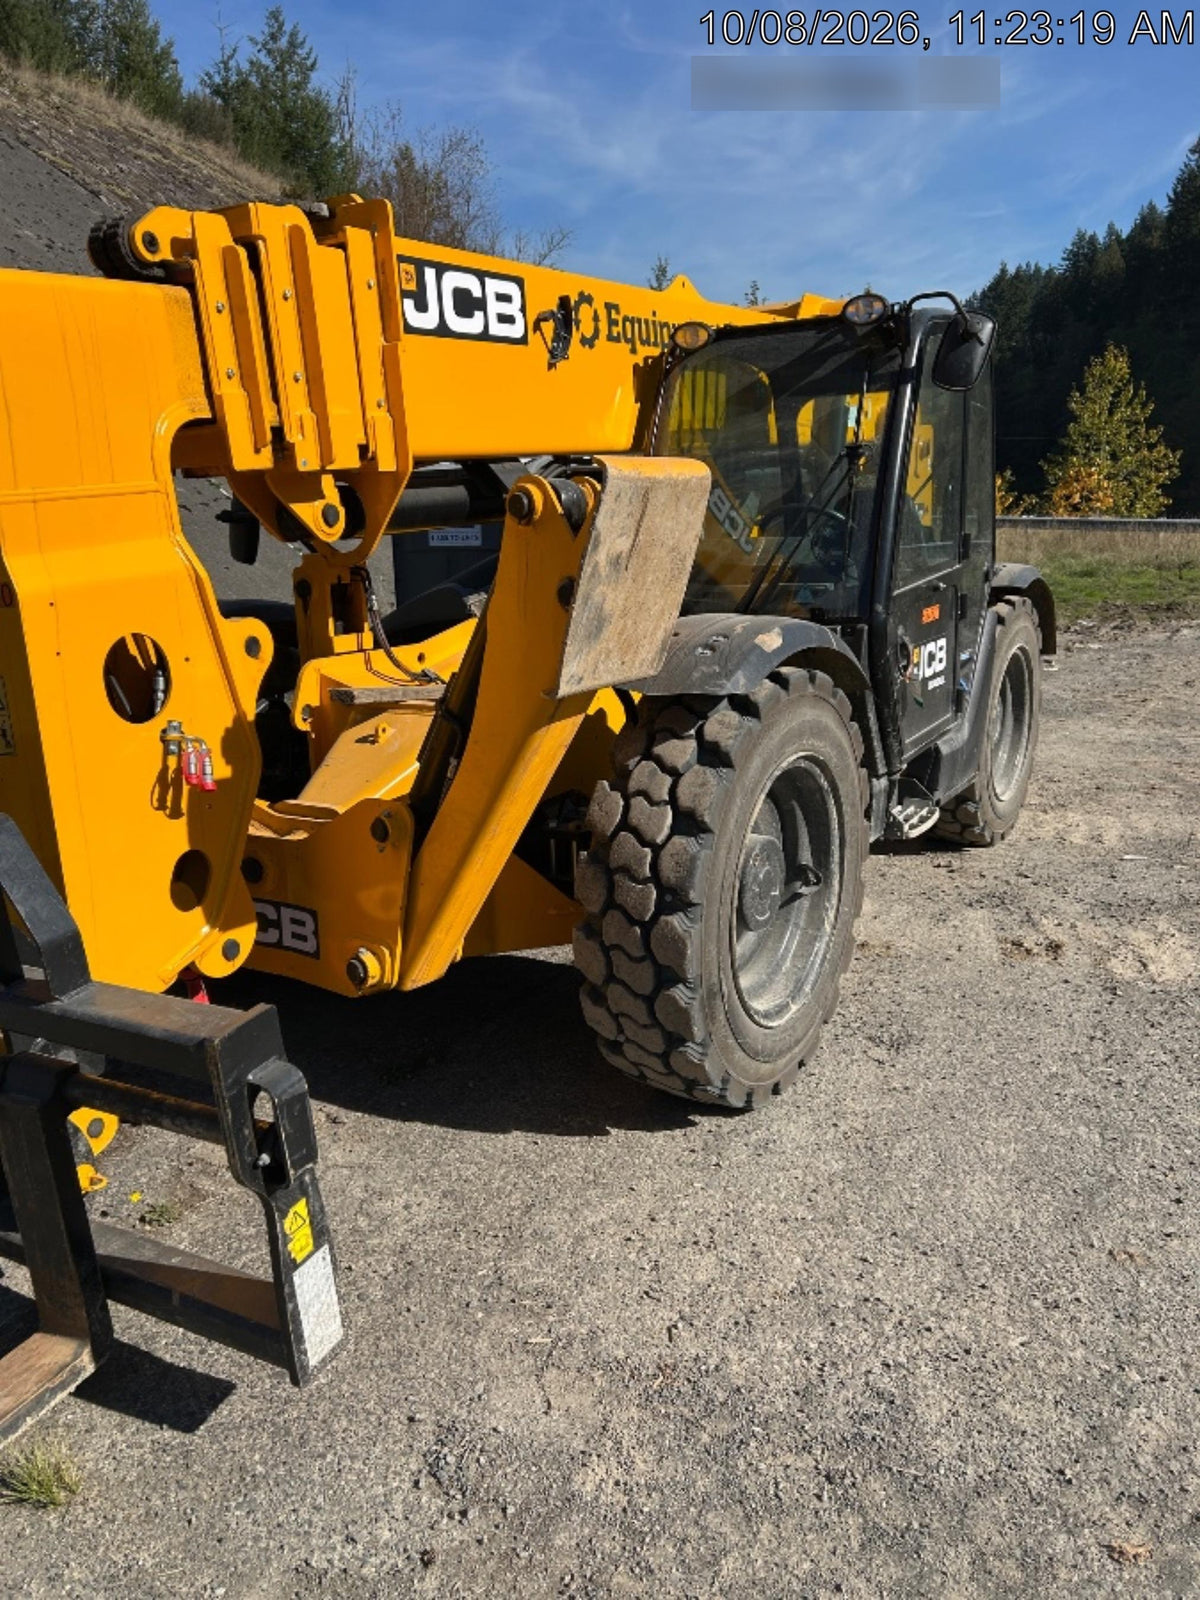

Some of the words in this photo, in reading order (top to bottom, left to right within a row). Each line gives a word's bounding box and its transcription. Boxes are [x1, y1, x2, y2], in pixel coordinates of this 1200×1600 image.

[402, 267, 526, 338] JCB
[604, 301, 681, 354] Equip
[255, 902, 318, 954] CB
